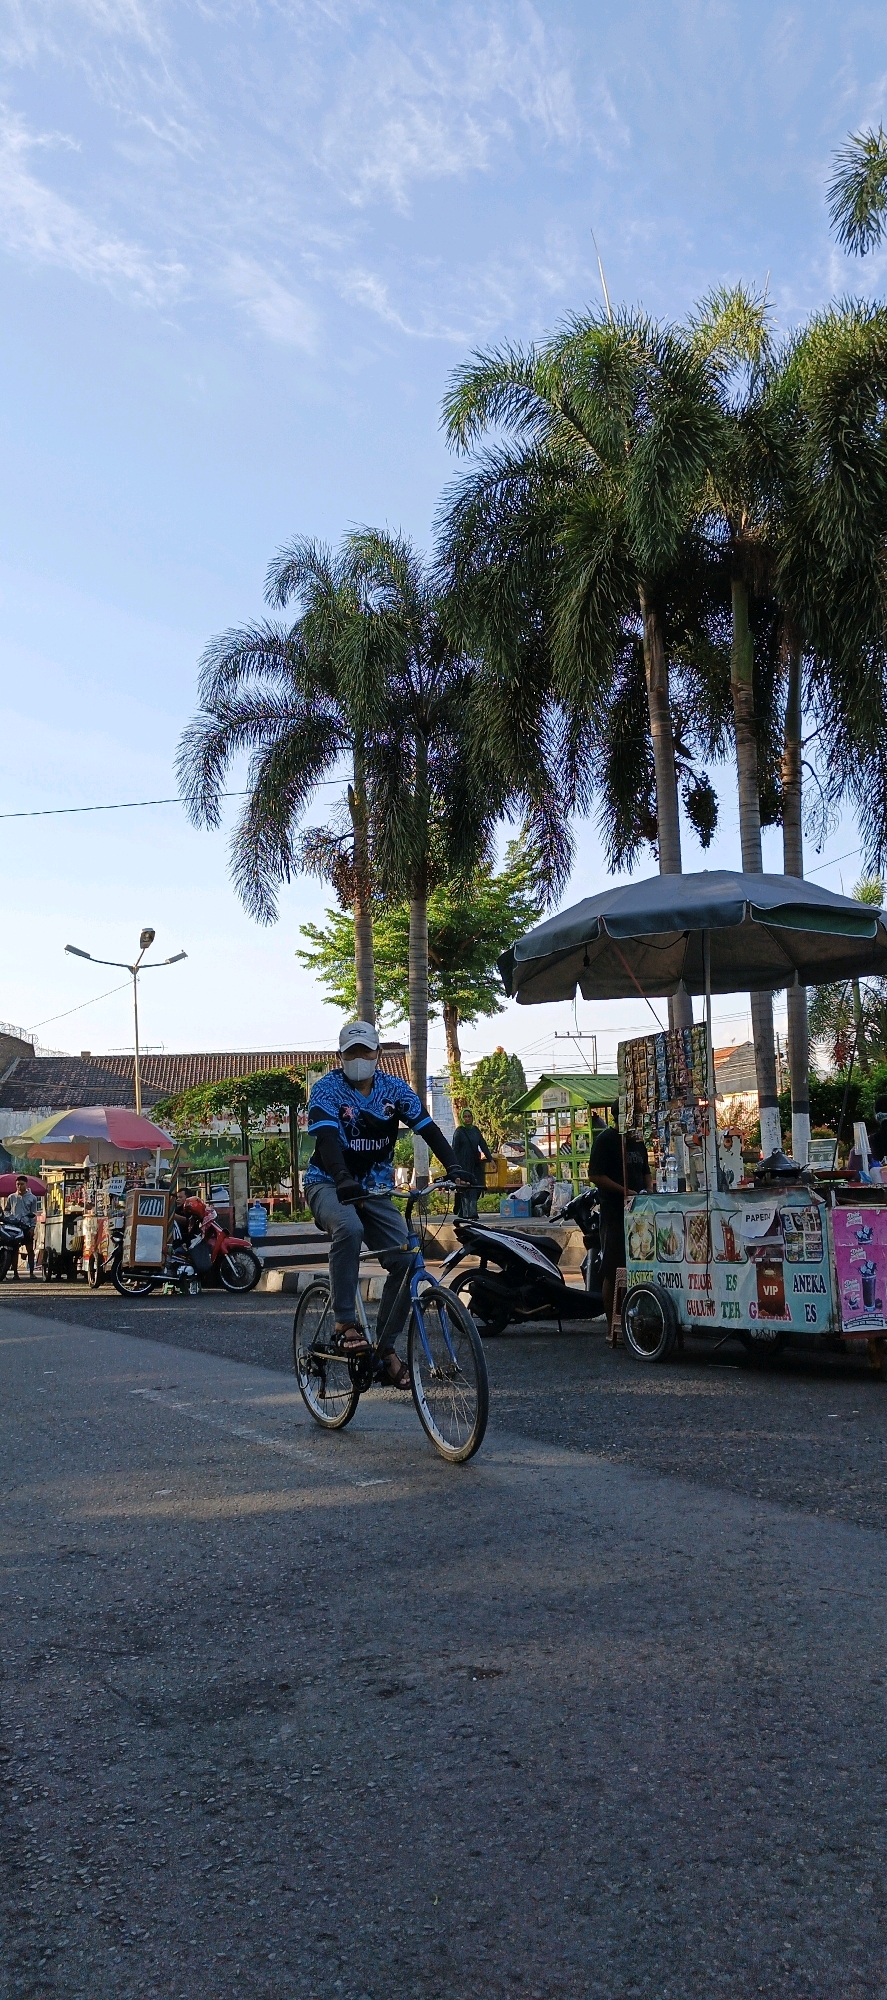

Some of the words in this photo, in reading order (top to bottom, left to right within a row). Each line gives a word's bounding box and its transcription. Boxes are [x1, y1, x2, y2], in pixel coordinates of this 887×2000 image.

[725, 1274, 738, 1291] ES
[762, 1285, 779, 1296] VIP
[792, 1273, 827, 1294] ANEKA
[804, 1303, 818, 1323] ES
